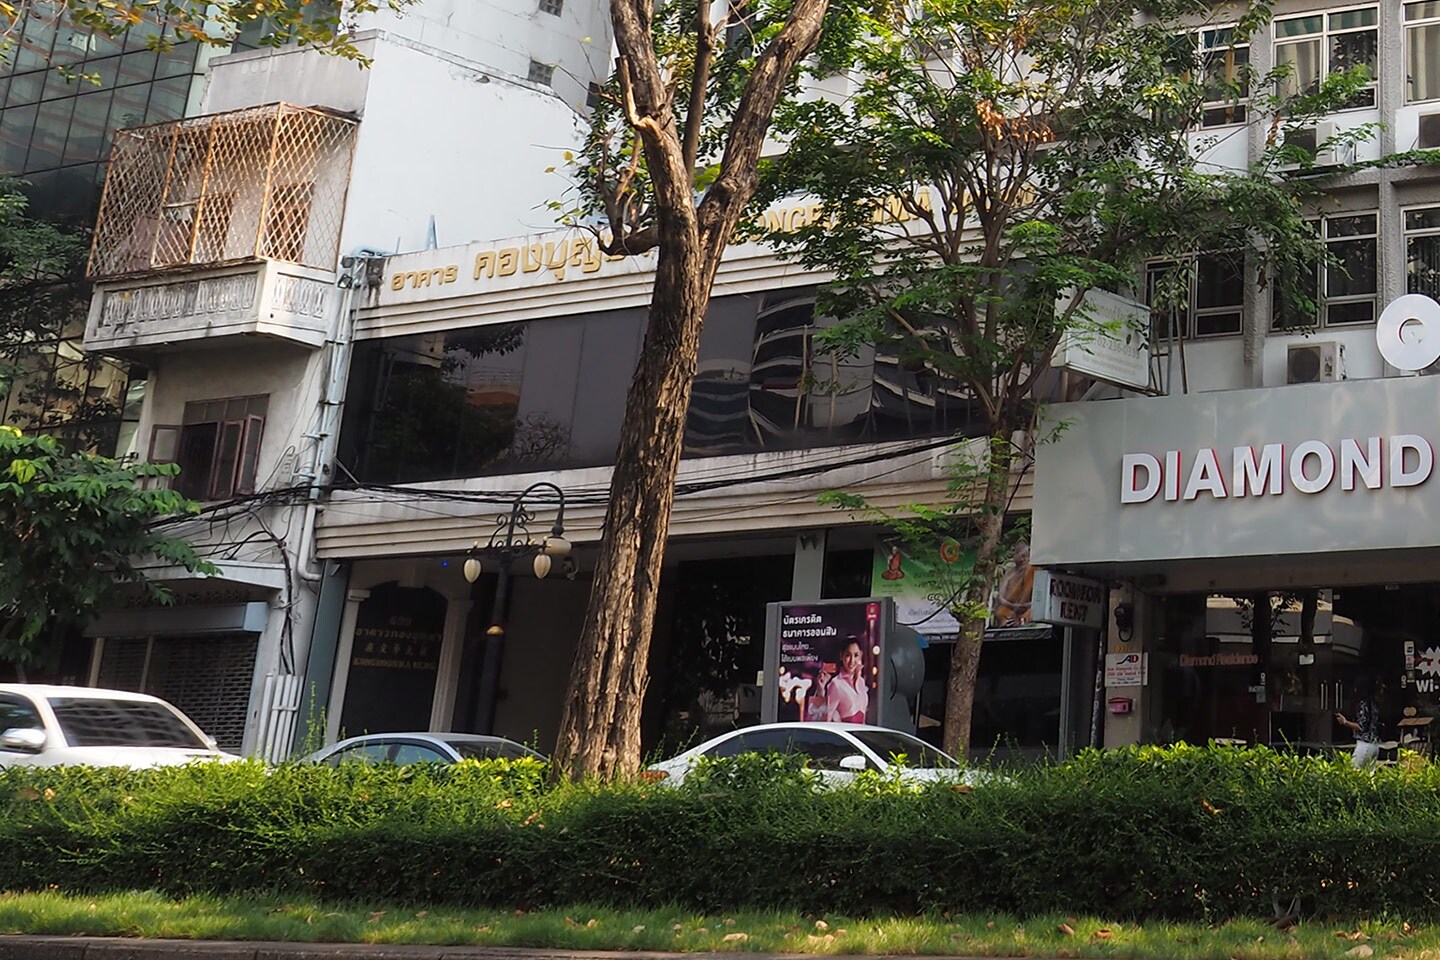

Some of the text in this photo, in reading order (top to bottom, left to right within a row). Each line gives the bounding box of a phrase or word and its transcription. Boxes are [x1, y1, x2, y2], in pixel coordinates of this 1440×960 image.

[391, 265, 459, 291] อาคาร
[1121, 434, 1436, 504] DIAMOND
[783, 614, 822, 626] บัตรเครดิต
[1060, 601, 1088, 622] RENT
[782, 626, 837, 638] ธนาคารออมสิน
